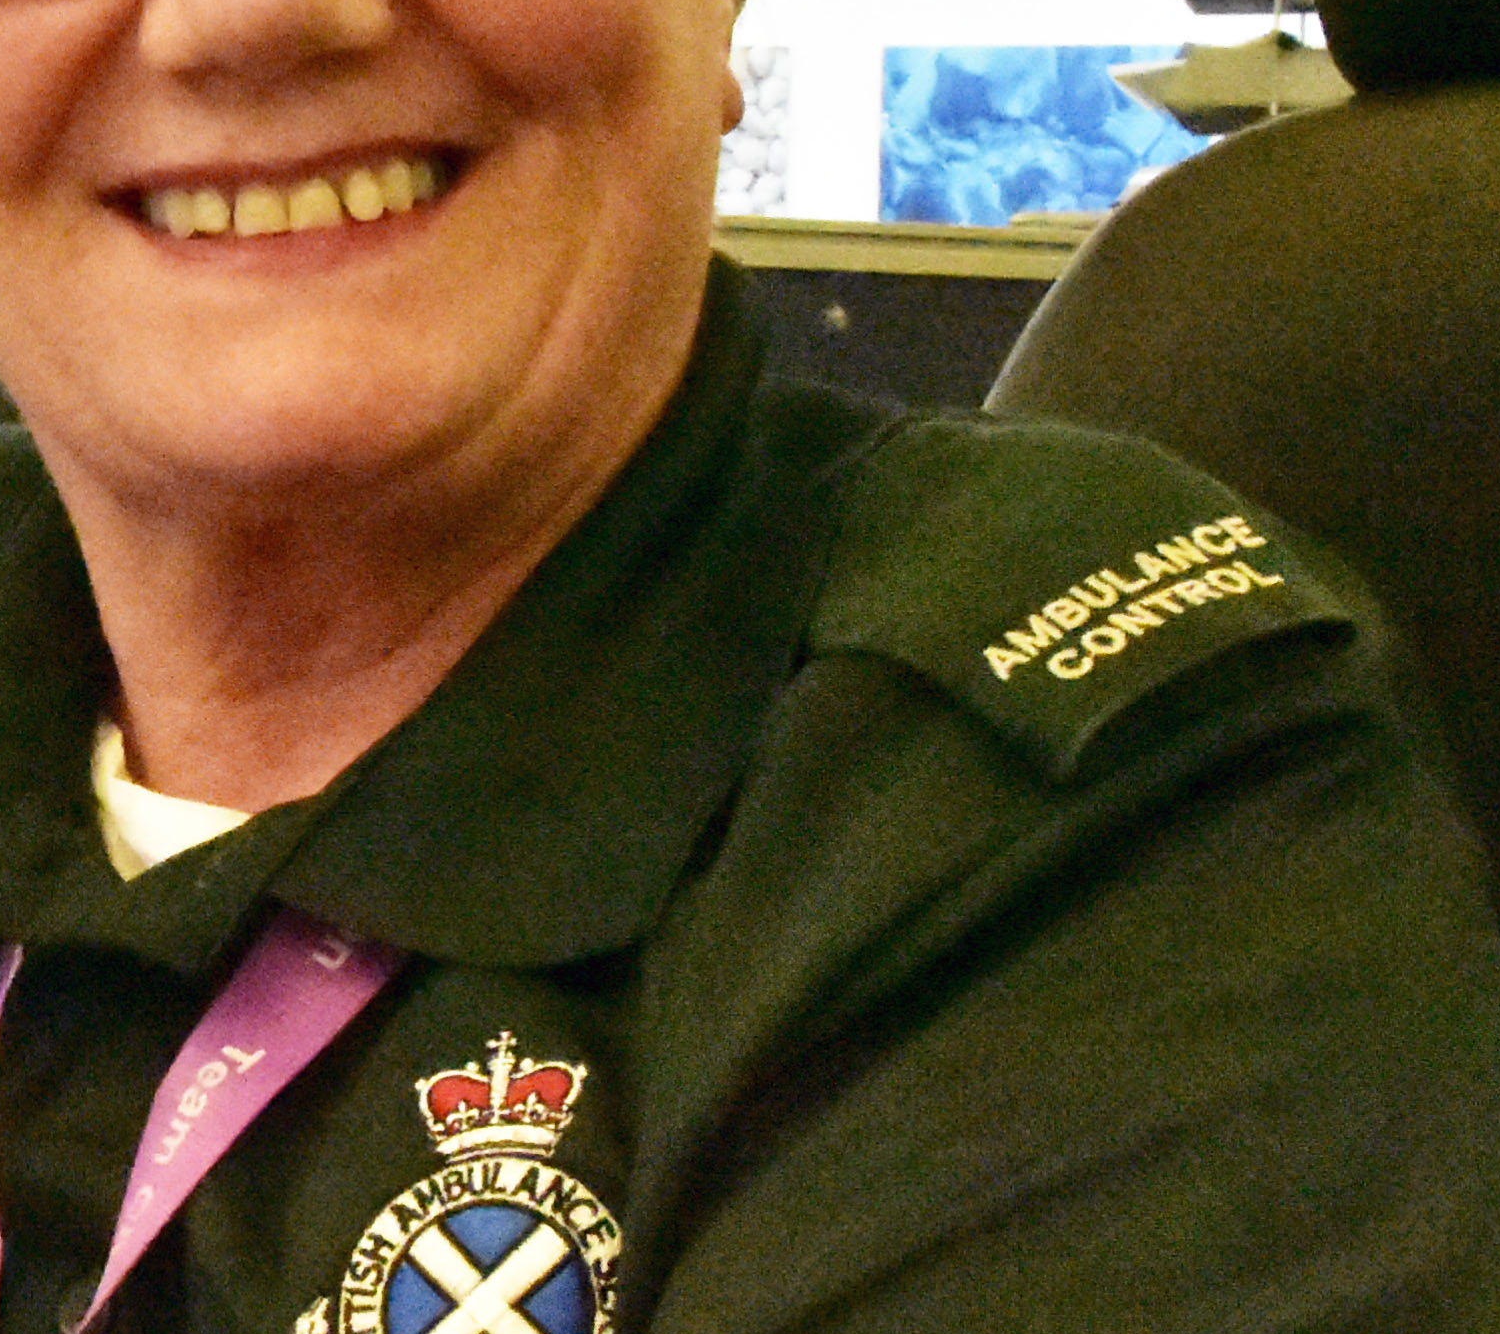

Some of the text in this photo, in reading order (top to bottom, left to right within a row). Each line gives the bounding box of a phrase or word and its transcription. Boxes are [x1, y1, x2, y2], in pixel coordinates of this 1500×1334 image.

[982, 514, 1268, 681] AMBULANCE
[1046, 560, 1285, 680] CONTROL
[153, 1043, 267, 1165] Team
[390, 1161, 619, 1253] AMBULANCE
